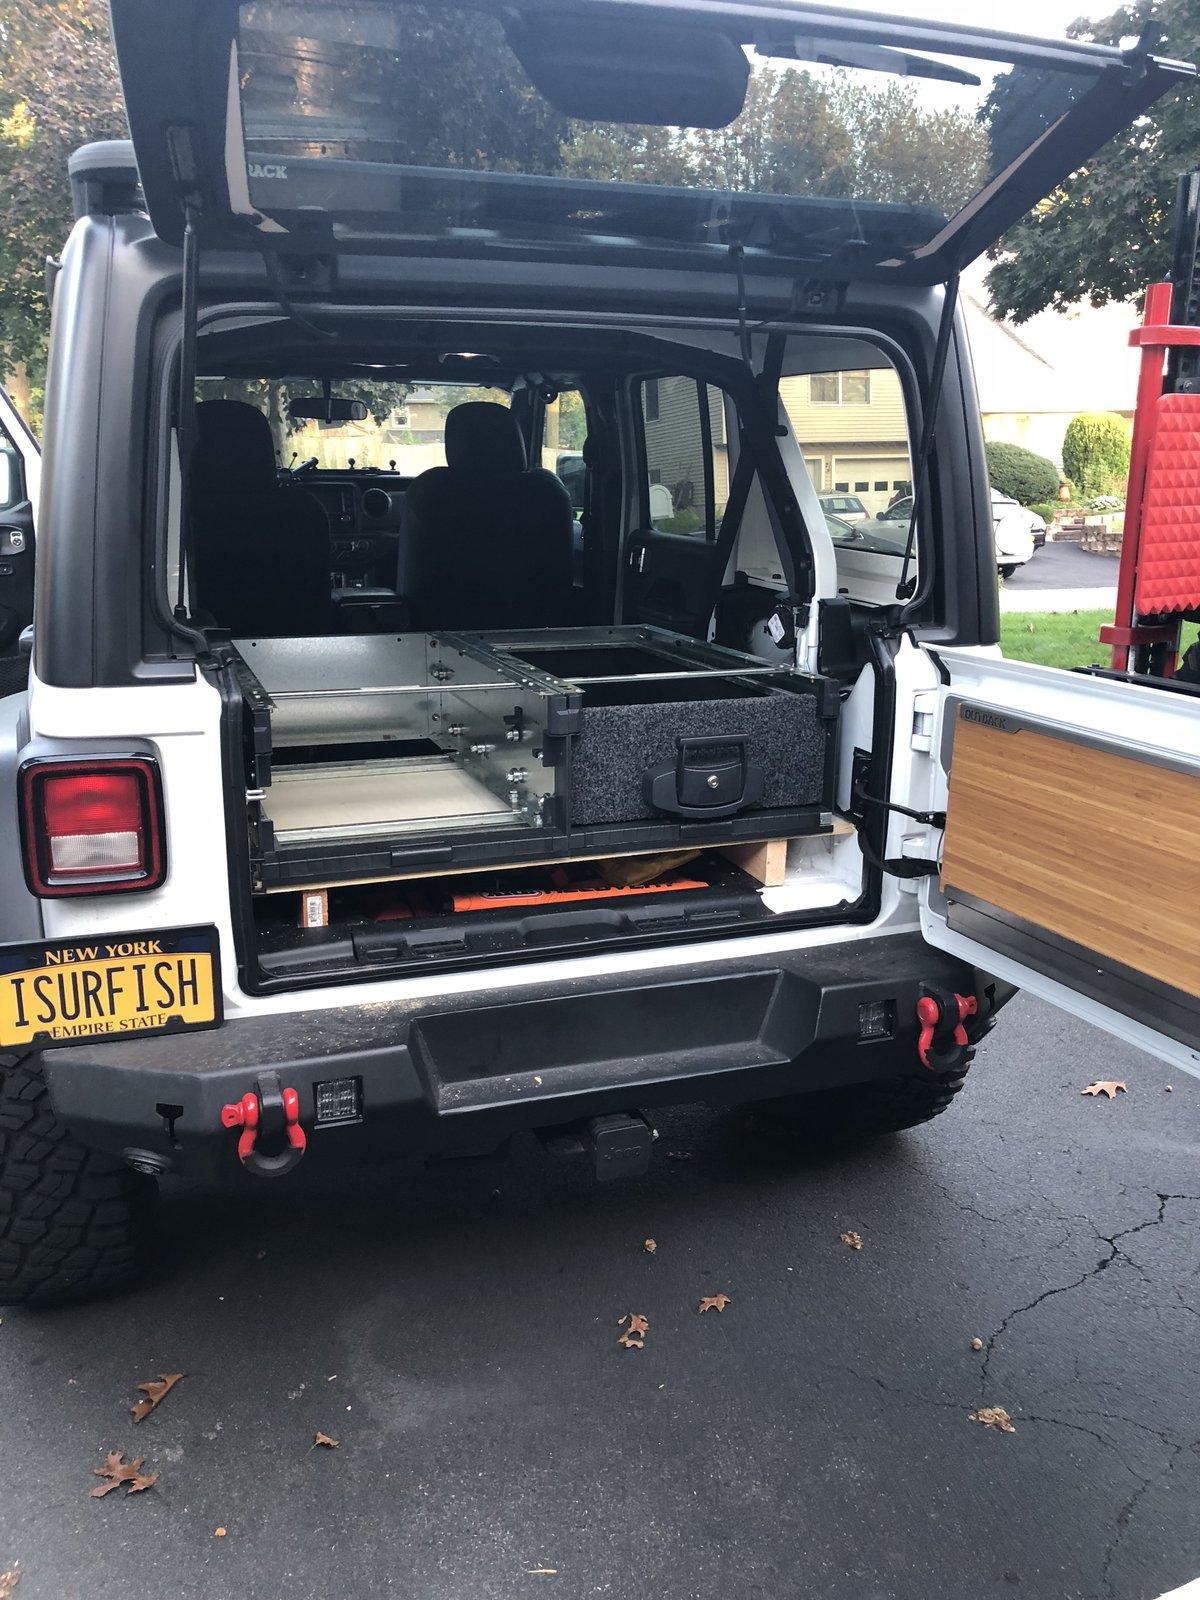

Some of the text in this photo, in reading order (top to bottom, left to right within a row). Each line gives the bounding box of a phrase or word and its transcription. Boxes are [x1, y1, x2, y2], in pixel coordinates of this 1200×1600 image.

[45, 940, 163, 966] NEW YORK
[11, 958, 199, 1027] ISURFISH
[53, 1013, 168, 1038] EMPIRE STATE
